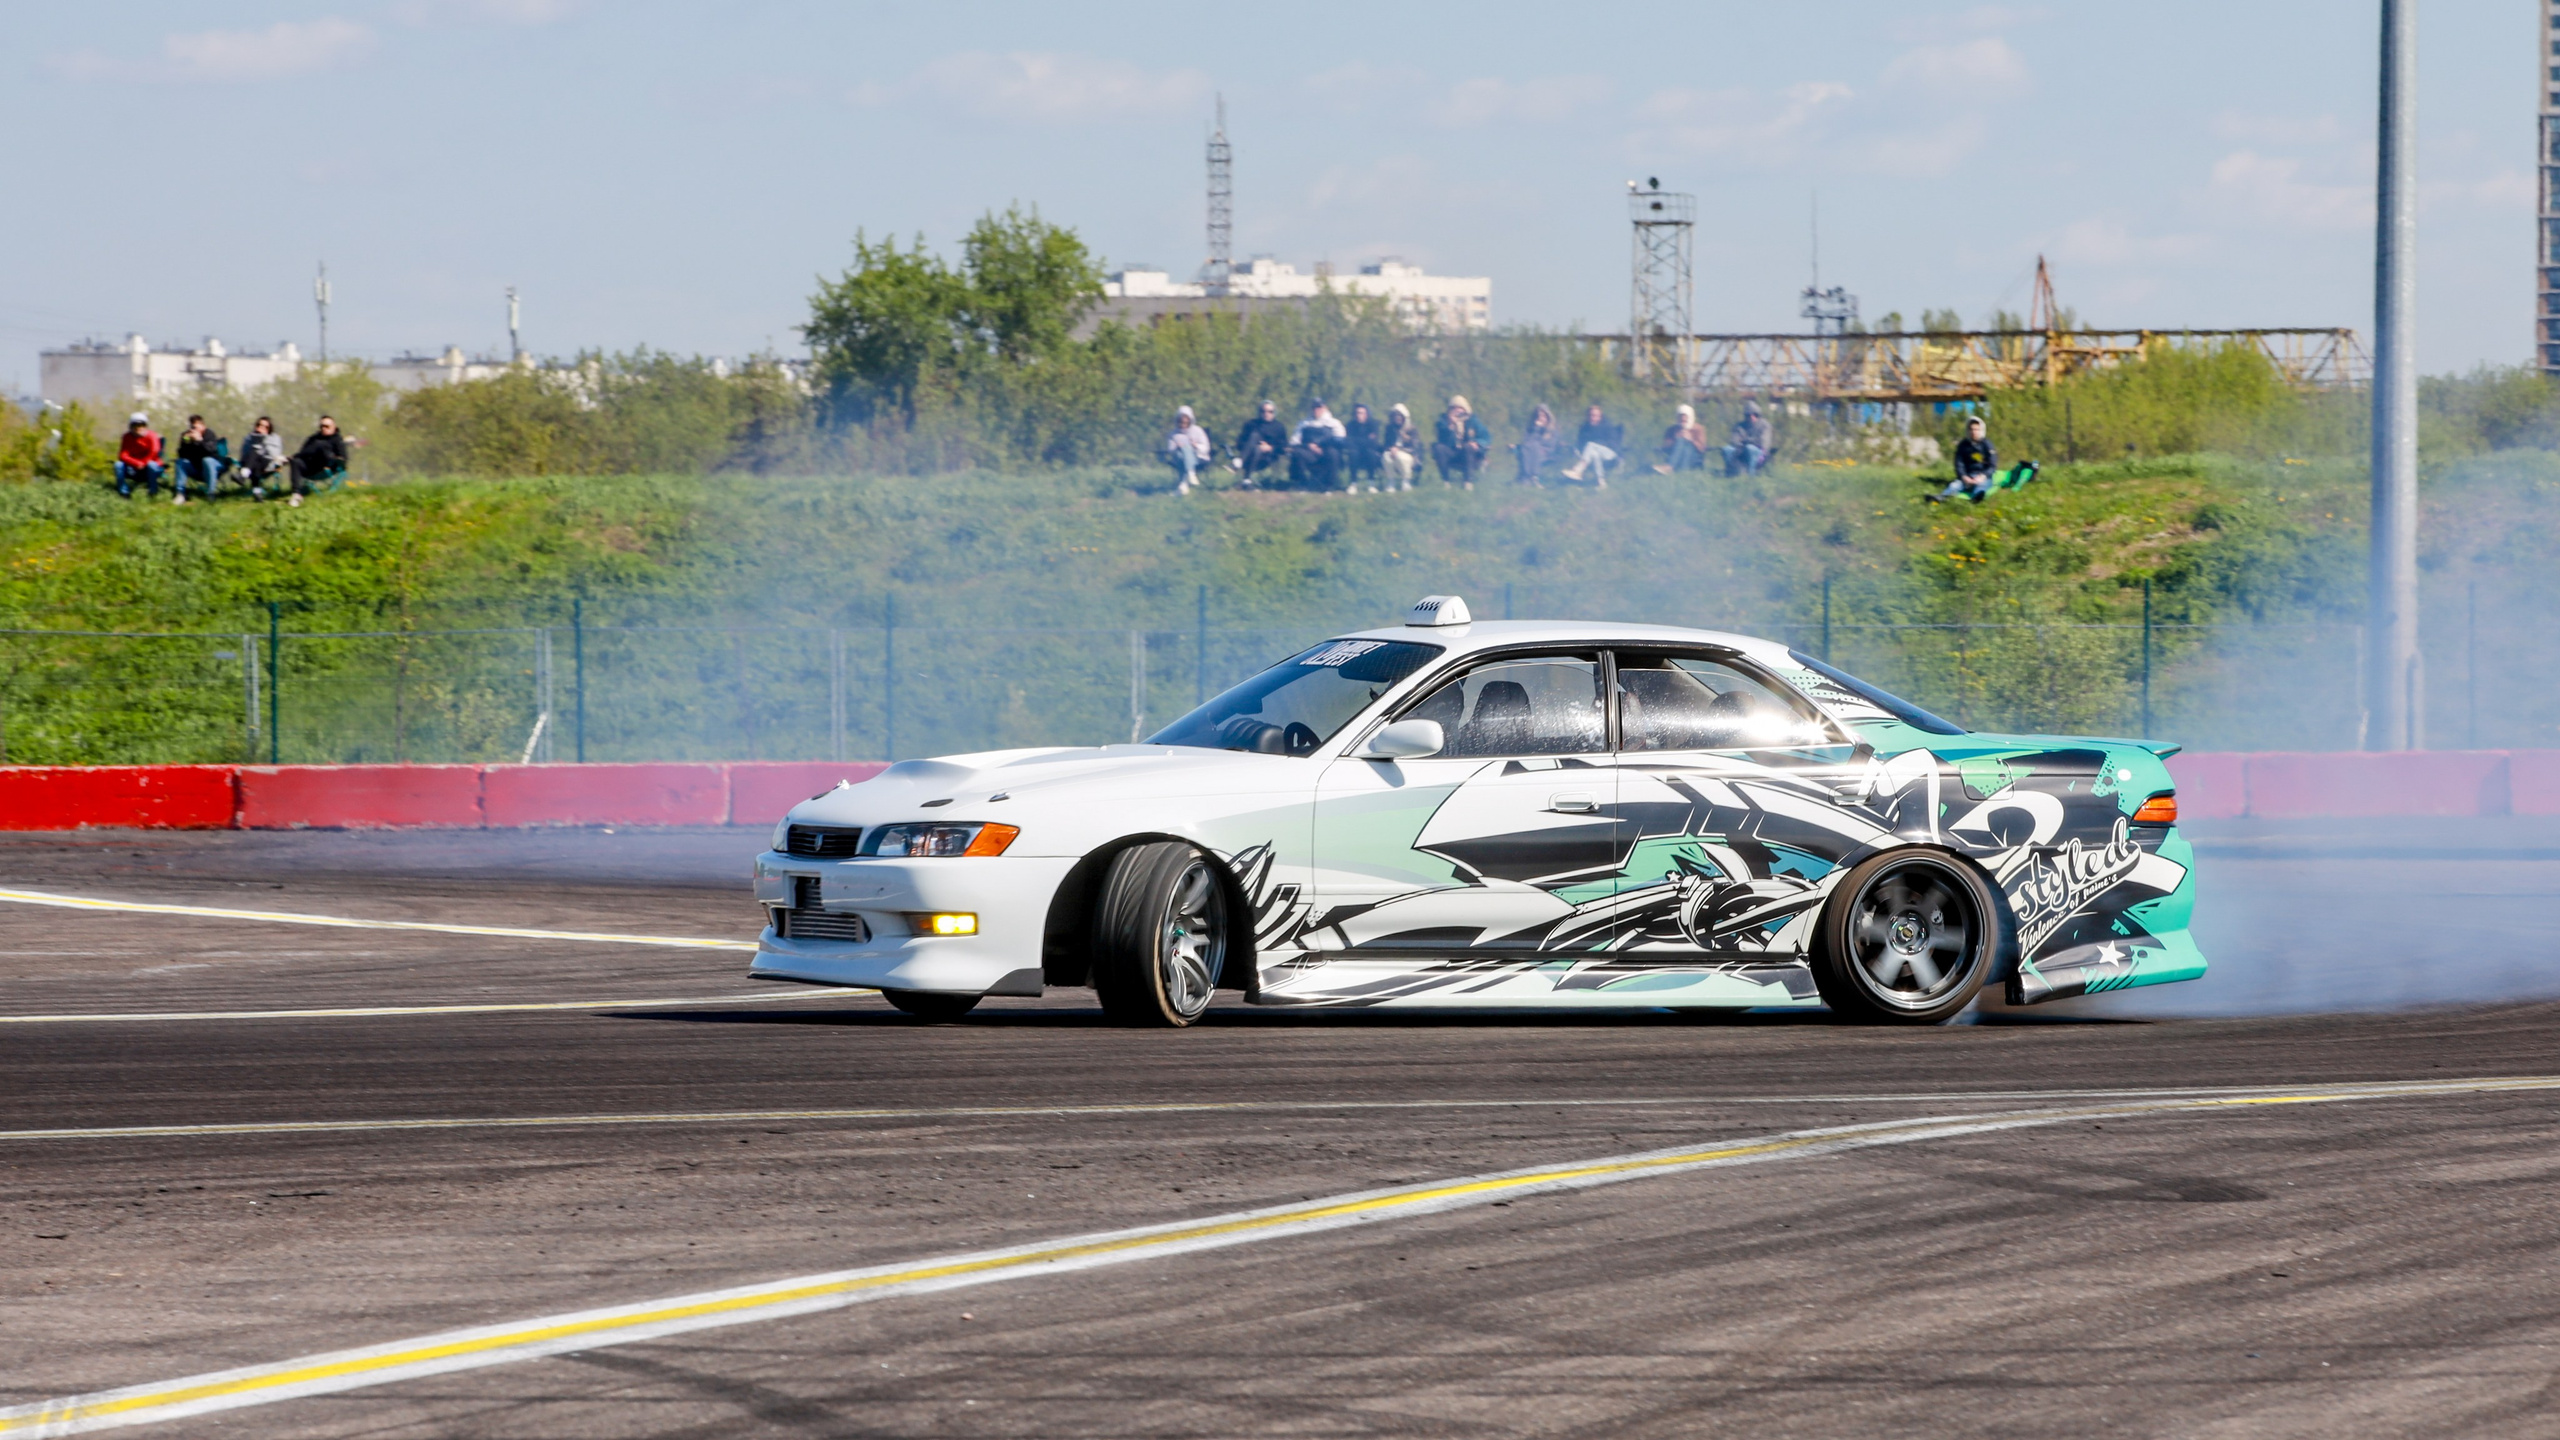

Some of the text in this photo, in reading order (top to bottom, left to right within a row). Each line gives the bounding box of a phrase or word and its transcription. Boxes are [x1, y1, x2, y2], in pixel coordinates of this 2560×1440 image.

[2018, 873, 2118, 960] Violence of paint's
[2019, 816, 2139, 922] styled
